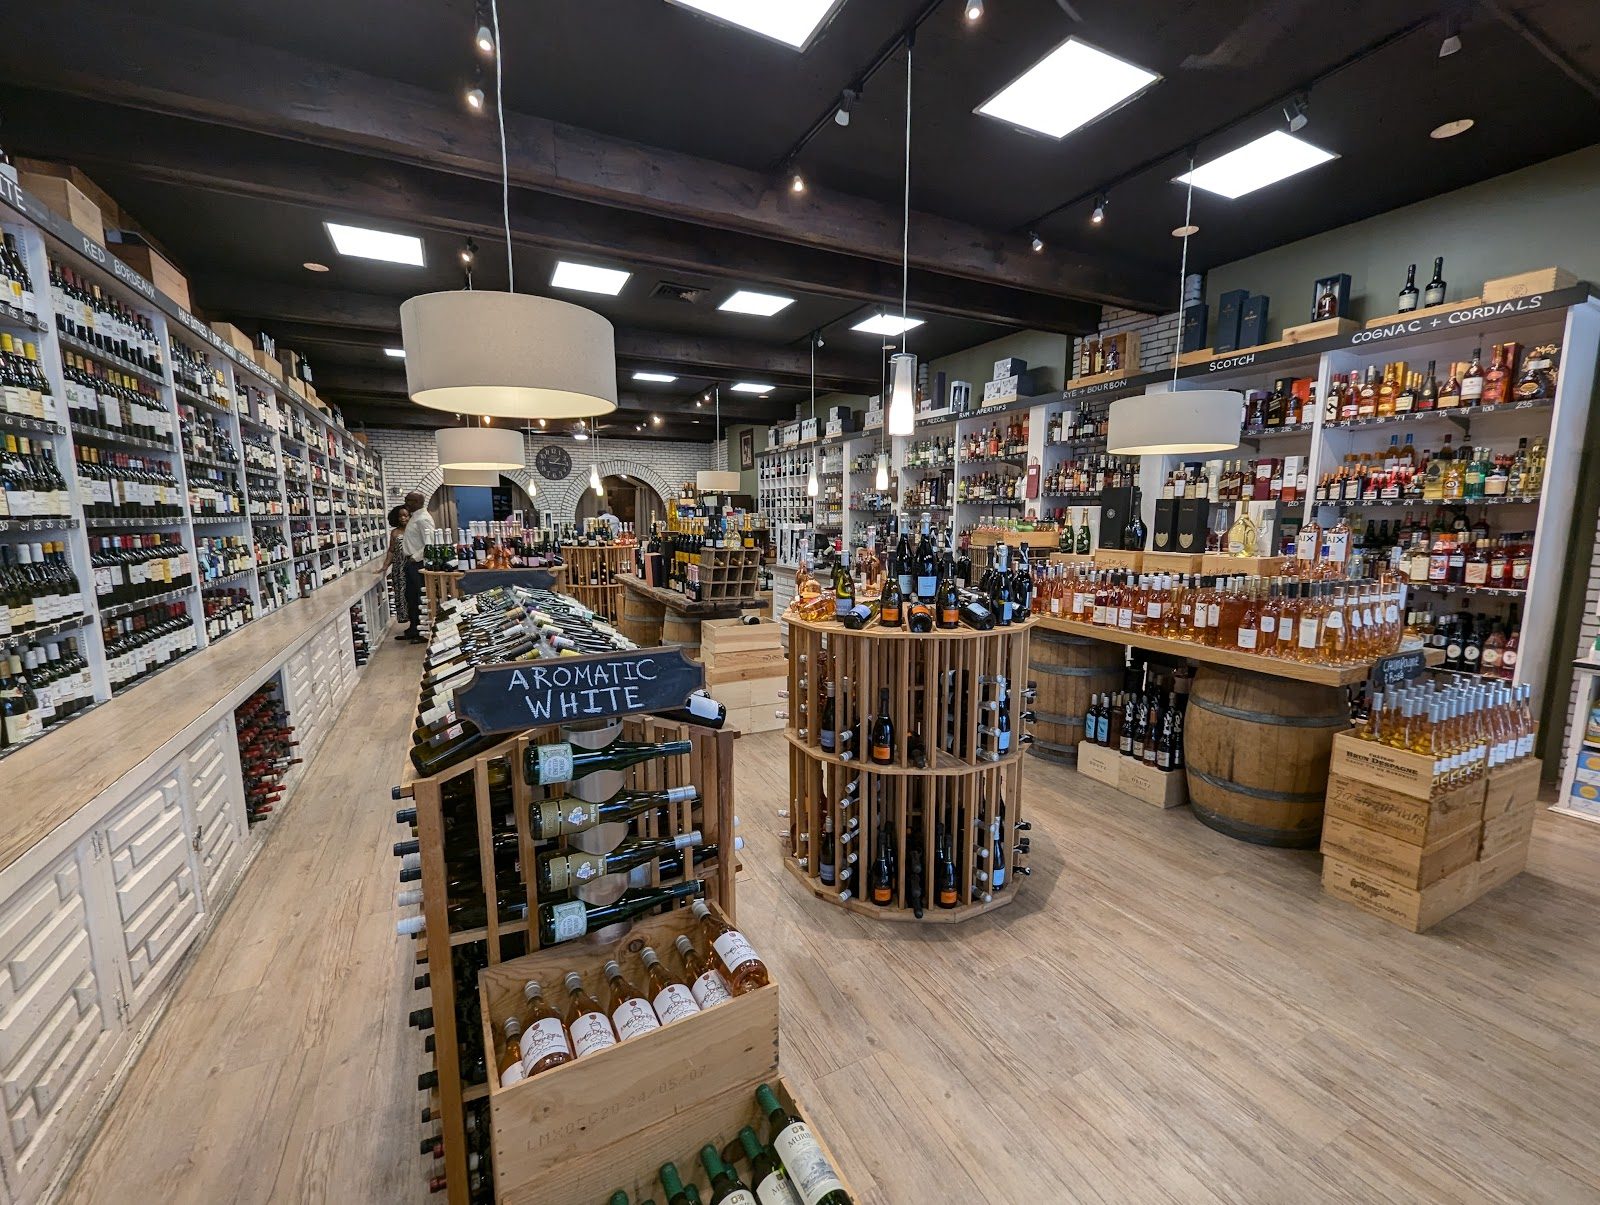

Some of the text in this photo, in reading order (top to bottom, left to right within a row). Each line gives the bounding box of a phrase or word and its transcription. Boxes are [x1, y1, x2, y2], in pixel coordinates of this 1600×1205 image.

[82, 236, 157, 300] RED BORDEAUX
[1351, 295, 1544, 345] COGNAC + CORDIALS
[1208, 353, 1256, 373] SCOTCH
[1062, 389, 1078, 400] RYE
[1086, 378, 1128, 394] BOURBON
[1327, 536, 1345, 544] AIX
[507, 658, 658, 692] AROMATIC
[524, 685, 646, 720] WHITE
[1346, 750, 1419, 775] BRUN DESPAGNE
